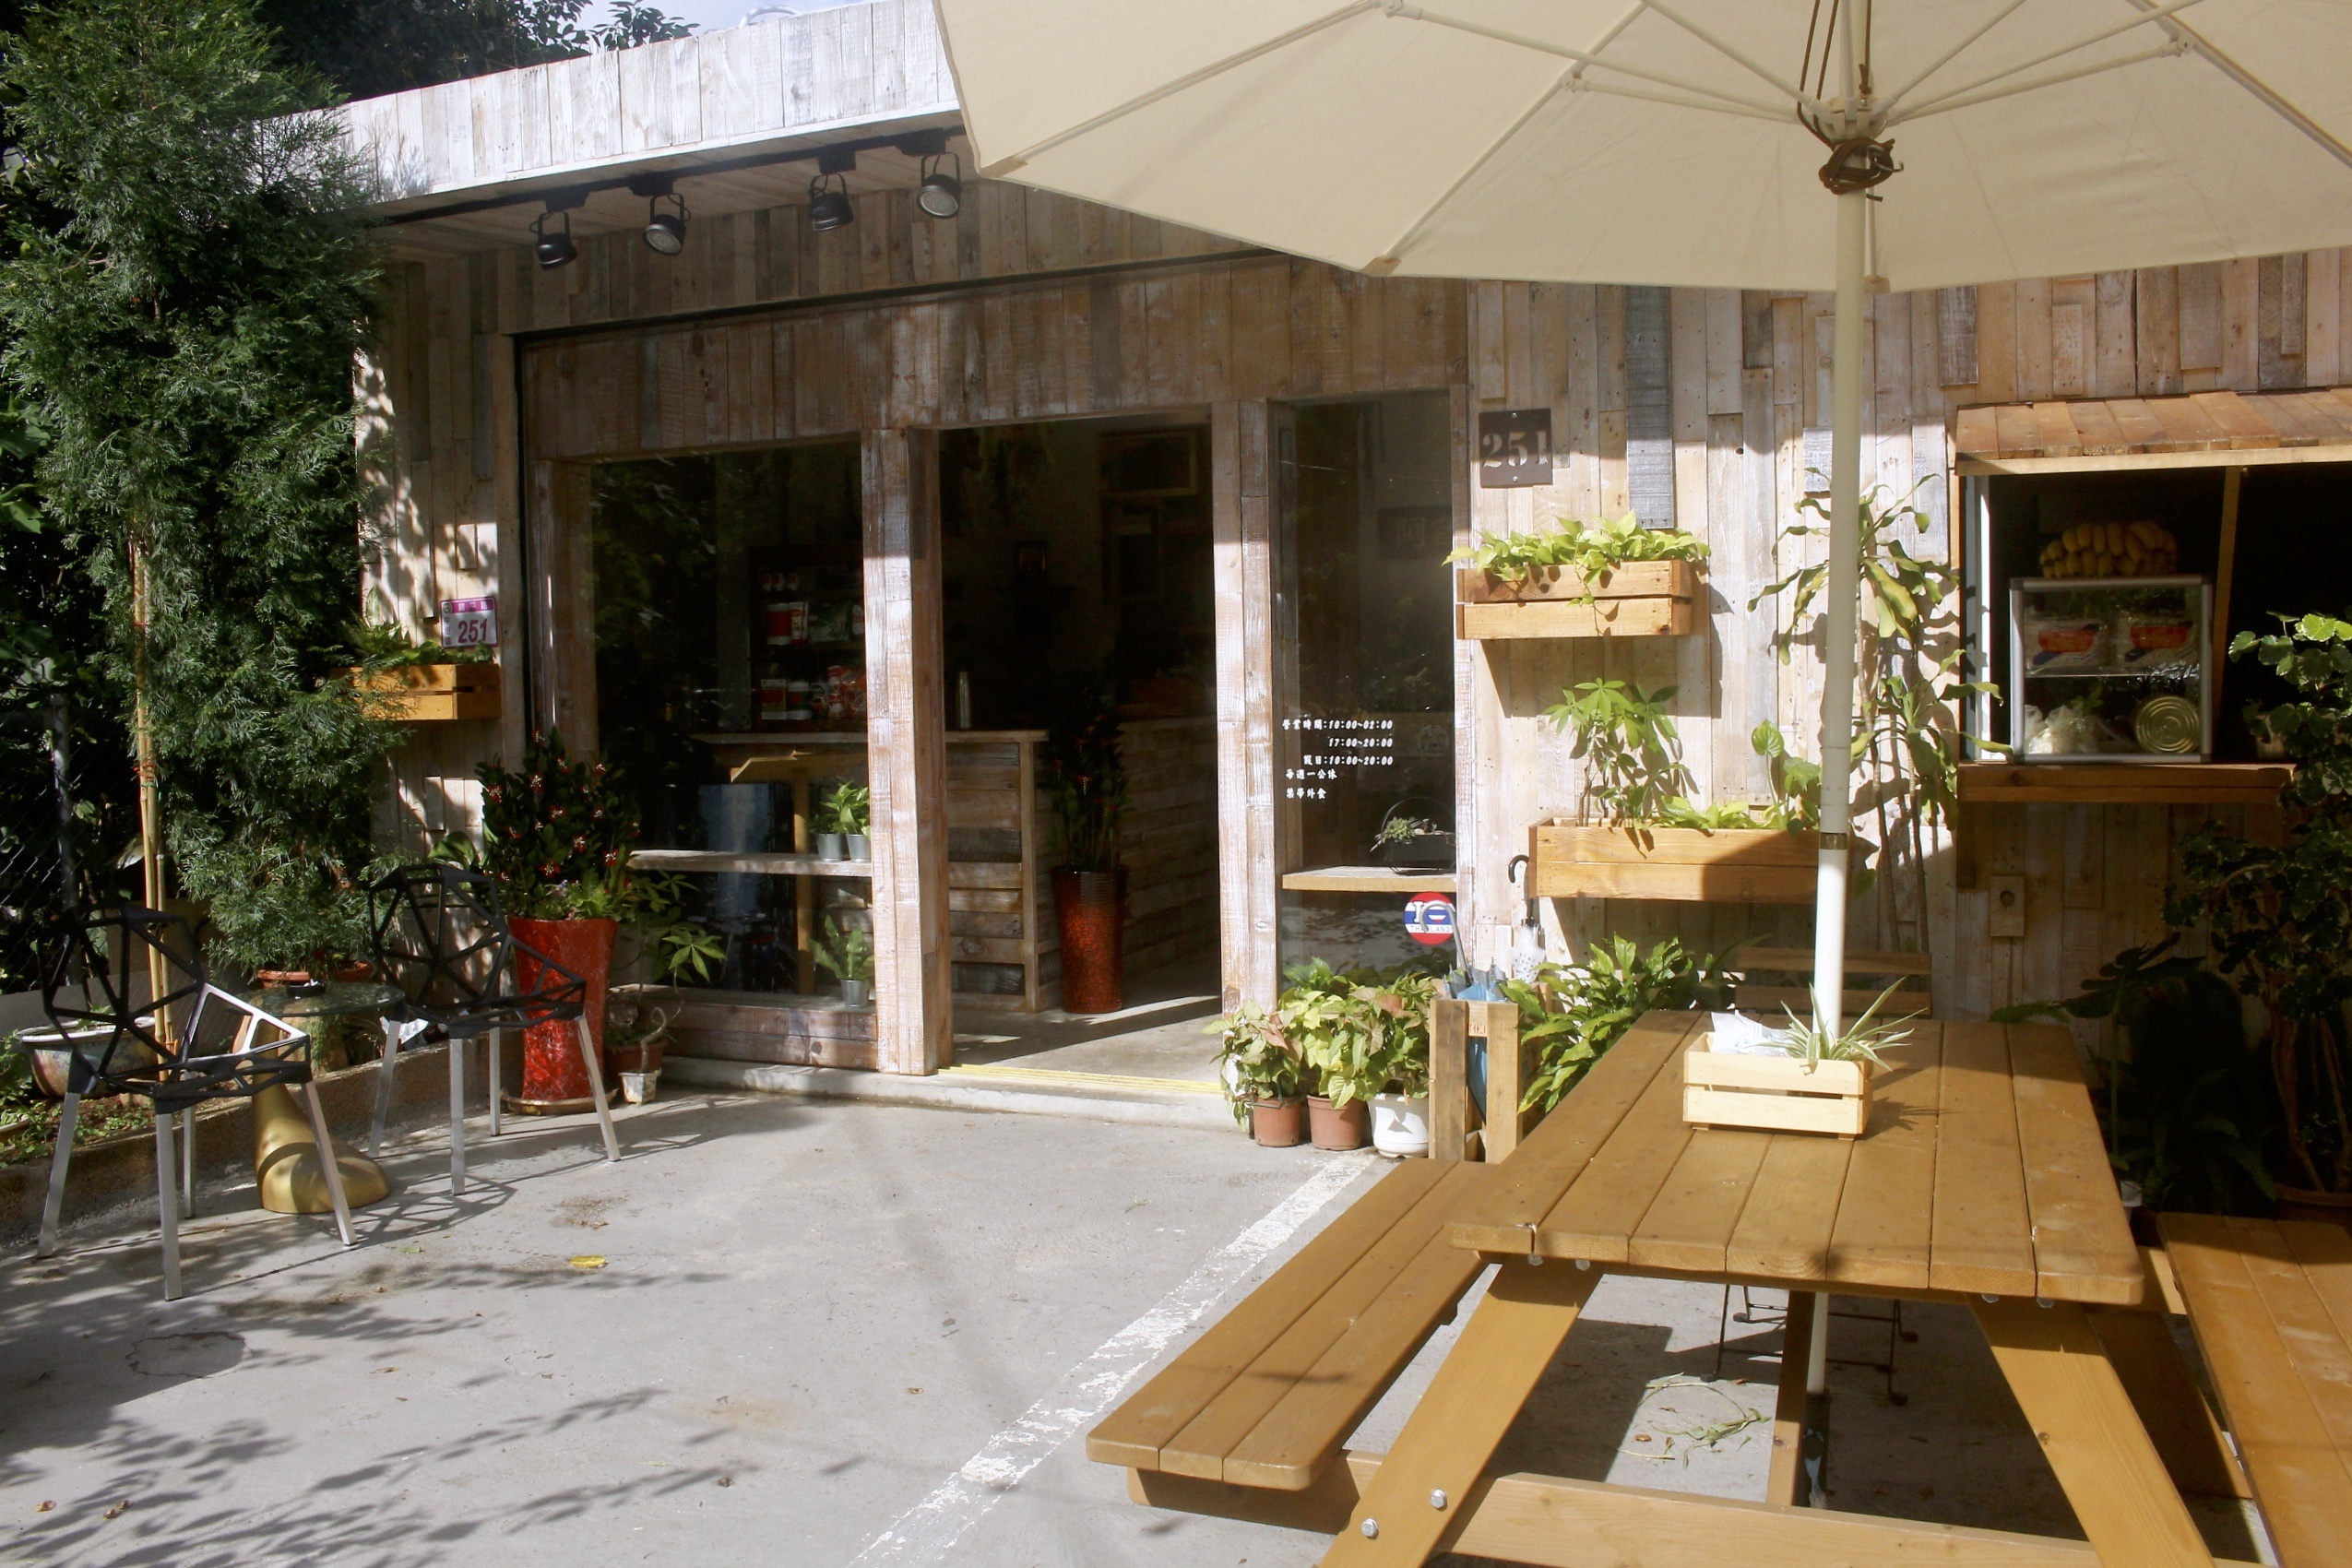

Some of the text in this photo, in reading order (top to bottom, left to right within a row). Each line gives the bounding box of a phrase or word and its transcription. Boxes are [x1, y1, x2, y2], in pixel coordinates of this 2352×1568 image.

[1482, 431, 1549, 468] 251
[457, 618, 488, 643] 251
[1410, 925, 1451, 933] THLAND
